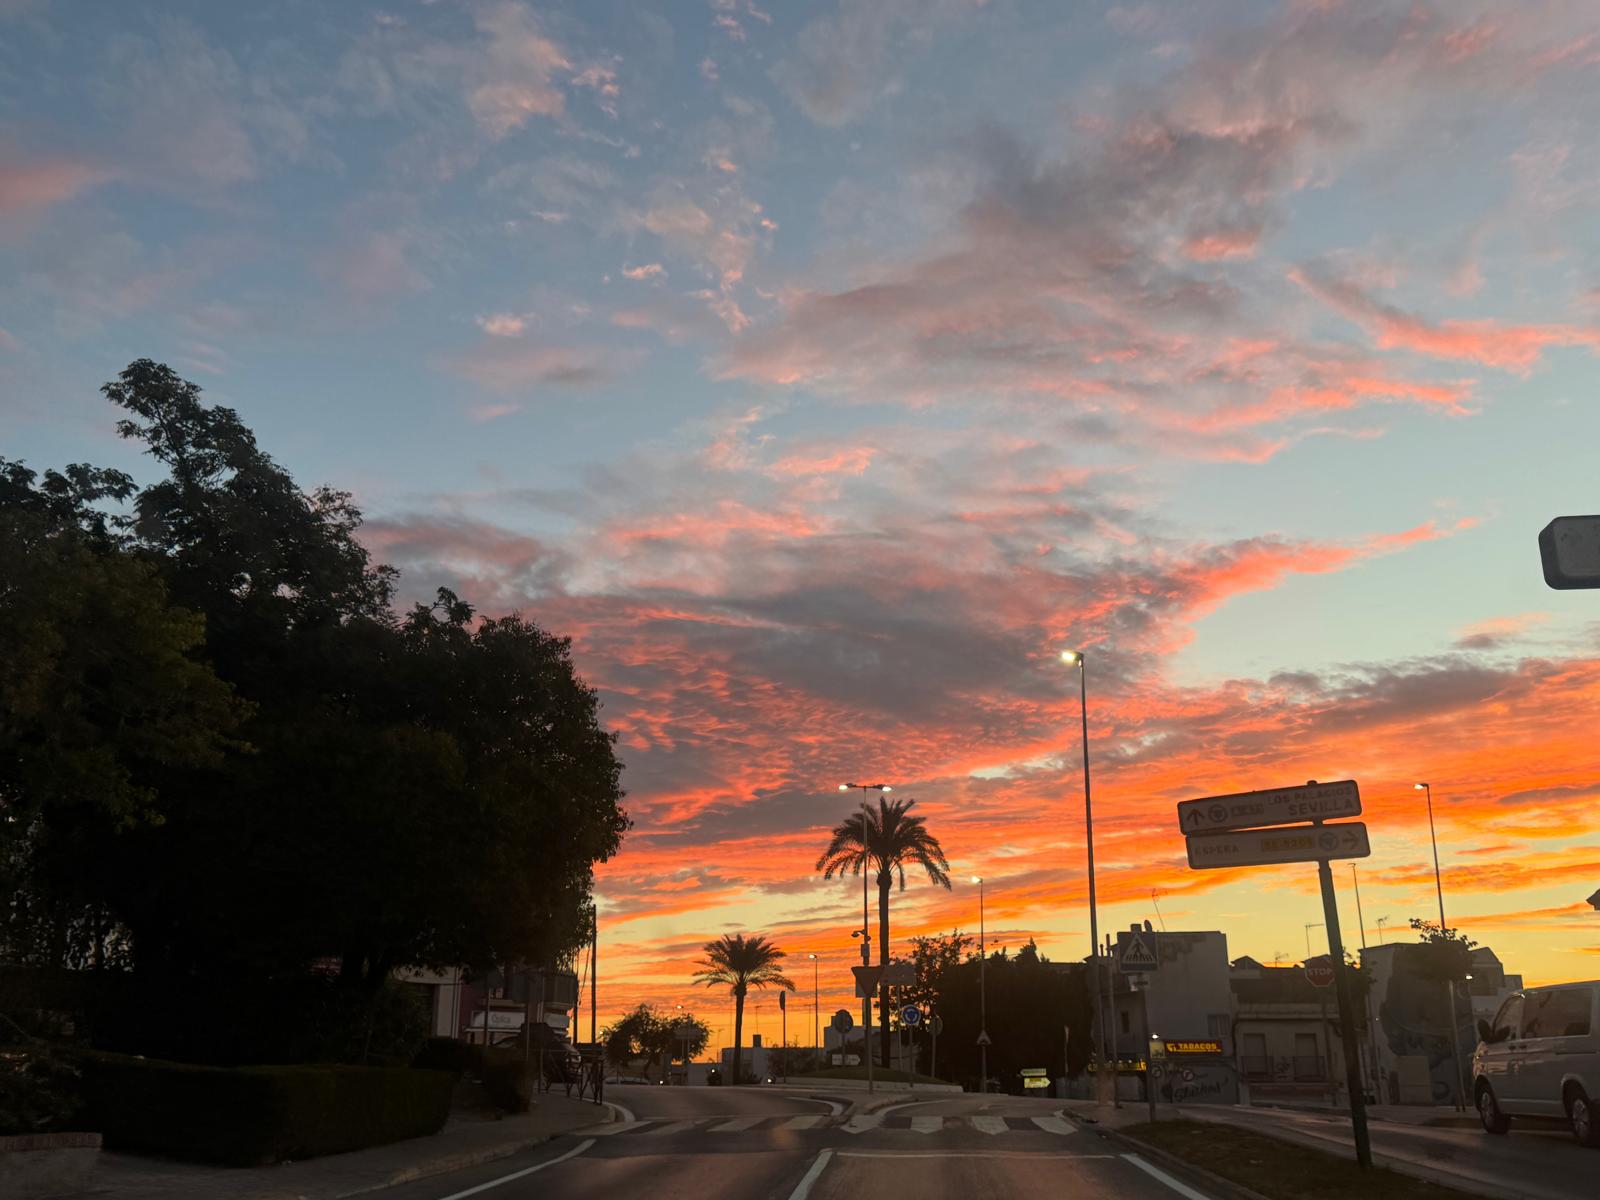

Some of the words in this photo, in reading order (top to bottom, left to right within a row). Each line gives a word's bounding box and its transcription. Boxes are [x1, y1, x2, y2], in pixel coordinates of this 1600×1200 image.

[1267, 794, 1290, 806] LOS
[1294, 786, 1353, 801] PALACIOS
[1287, 798, 1353, 816] SEVILLA
[1194, 844, 1240, 856] ESPERA
[1307, 966, 1333, 976] STOP
[1178, 1042, 1217, 1050] TABACOS
